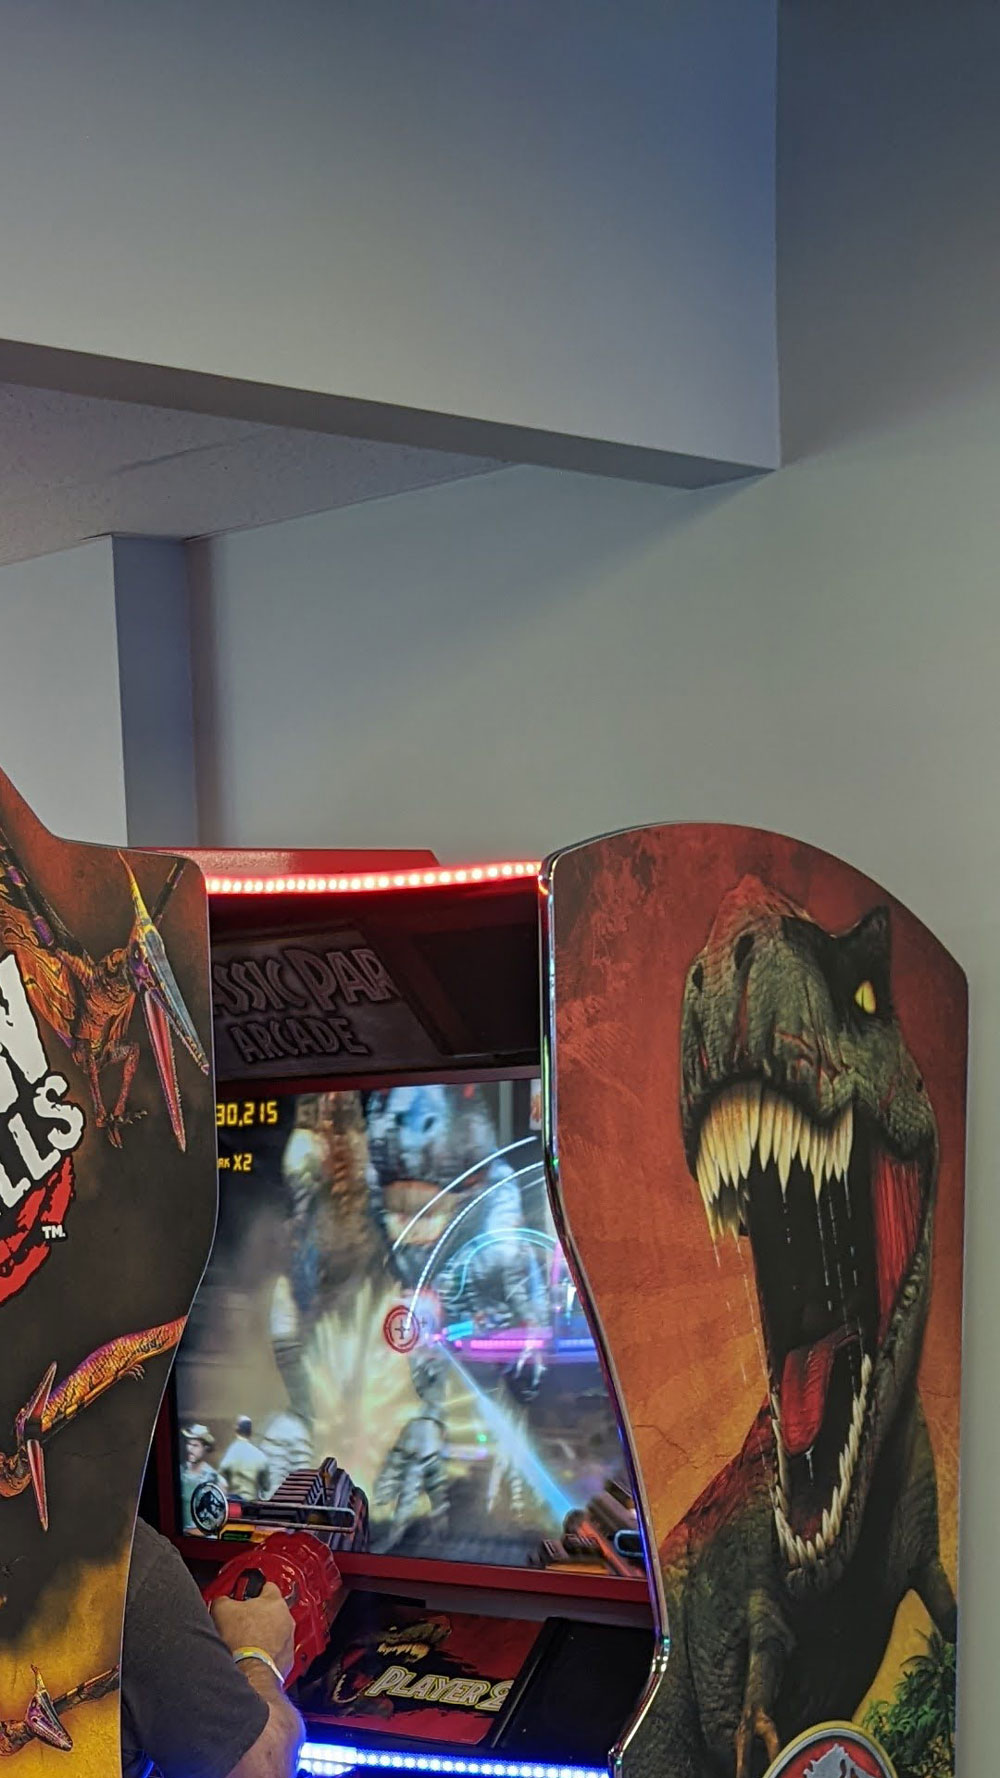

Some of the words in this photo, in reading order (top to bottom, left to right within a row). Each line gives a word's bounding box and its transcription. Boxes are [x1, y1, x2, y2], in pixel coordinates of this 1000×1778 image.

[230, 1016, 370, 1063] ARCADE
[233, 1152, 253, 1172] X2
[364, 1665, 491, 1706] PLAYER
[475, 1679, 515, 1712] 2
